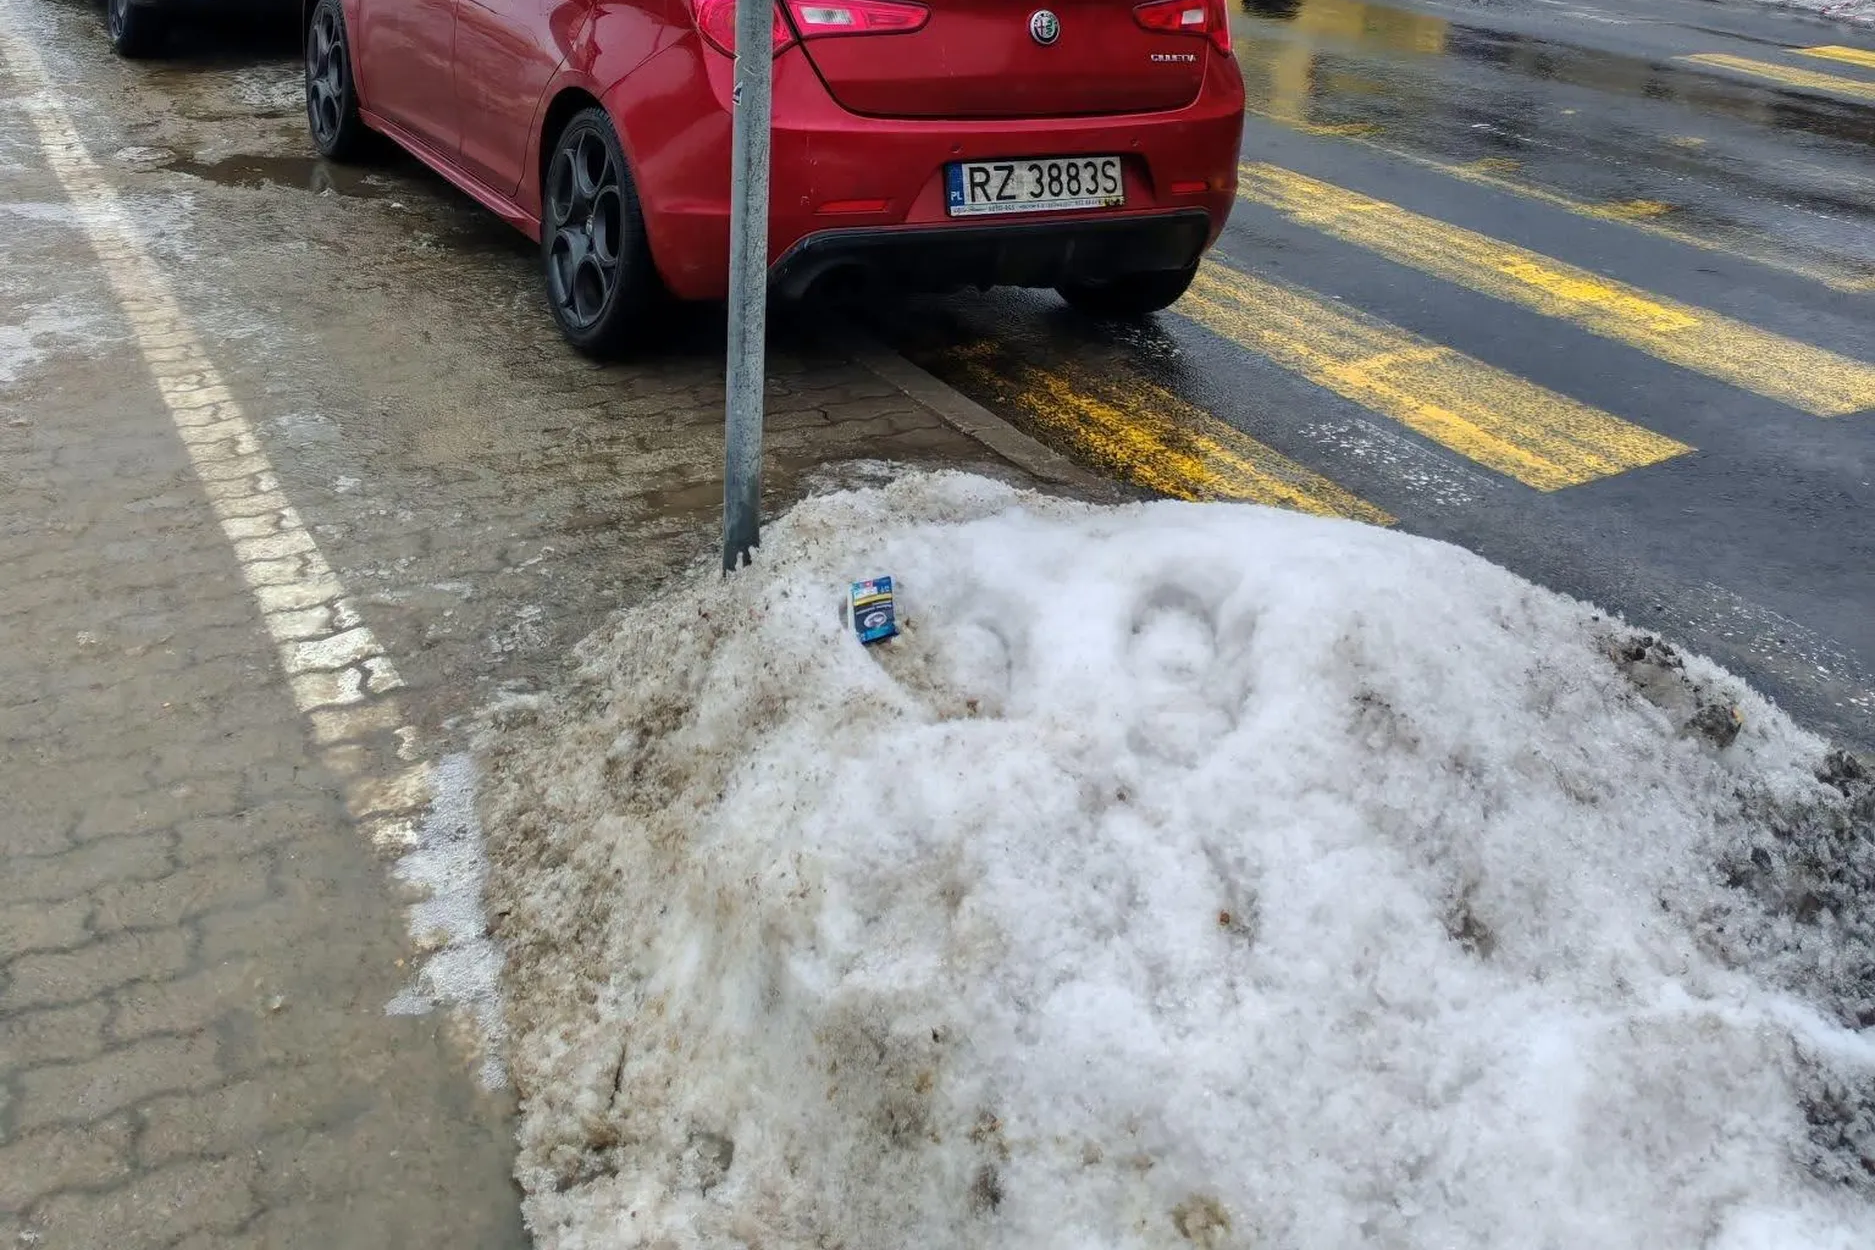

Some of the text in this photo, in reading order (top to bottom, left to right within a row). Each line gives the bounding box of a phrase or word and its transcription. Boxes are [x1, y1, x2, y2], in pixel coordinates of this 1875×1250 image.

[950, 160, 1118, 202] PL RZ 3883S
